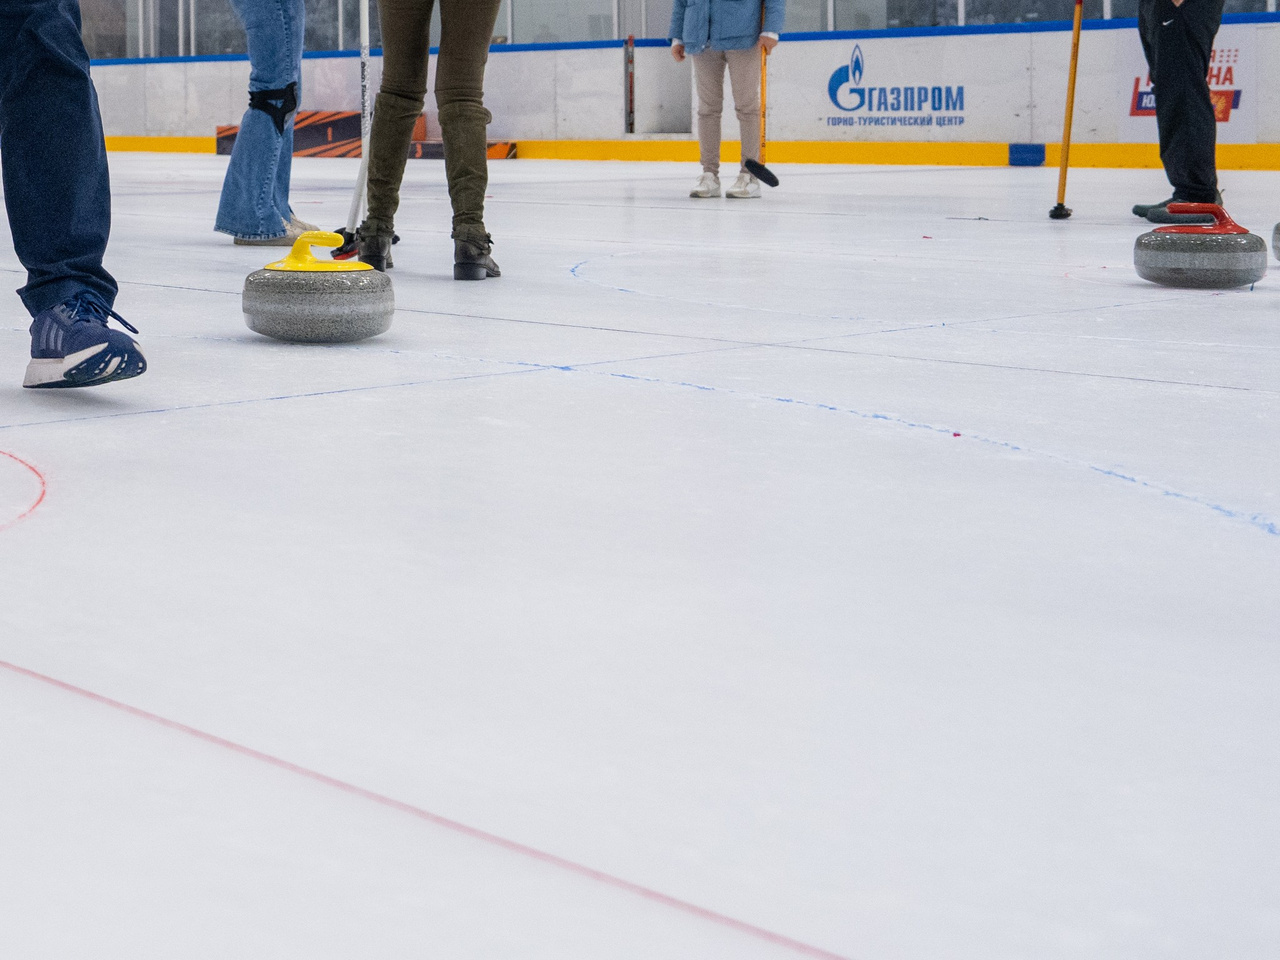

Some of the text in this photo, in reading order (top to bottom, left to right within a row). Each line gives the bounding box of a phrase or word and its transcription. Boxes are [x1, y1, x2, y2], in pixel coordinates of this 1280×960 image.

[867, 86, 964, 111] ГАЗПРОМ
[827, 114, 964, 127] ГОРНО-ТУРИСТИЧЕСКИЙ ЦЕНТР
